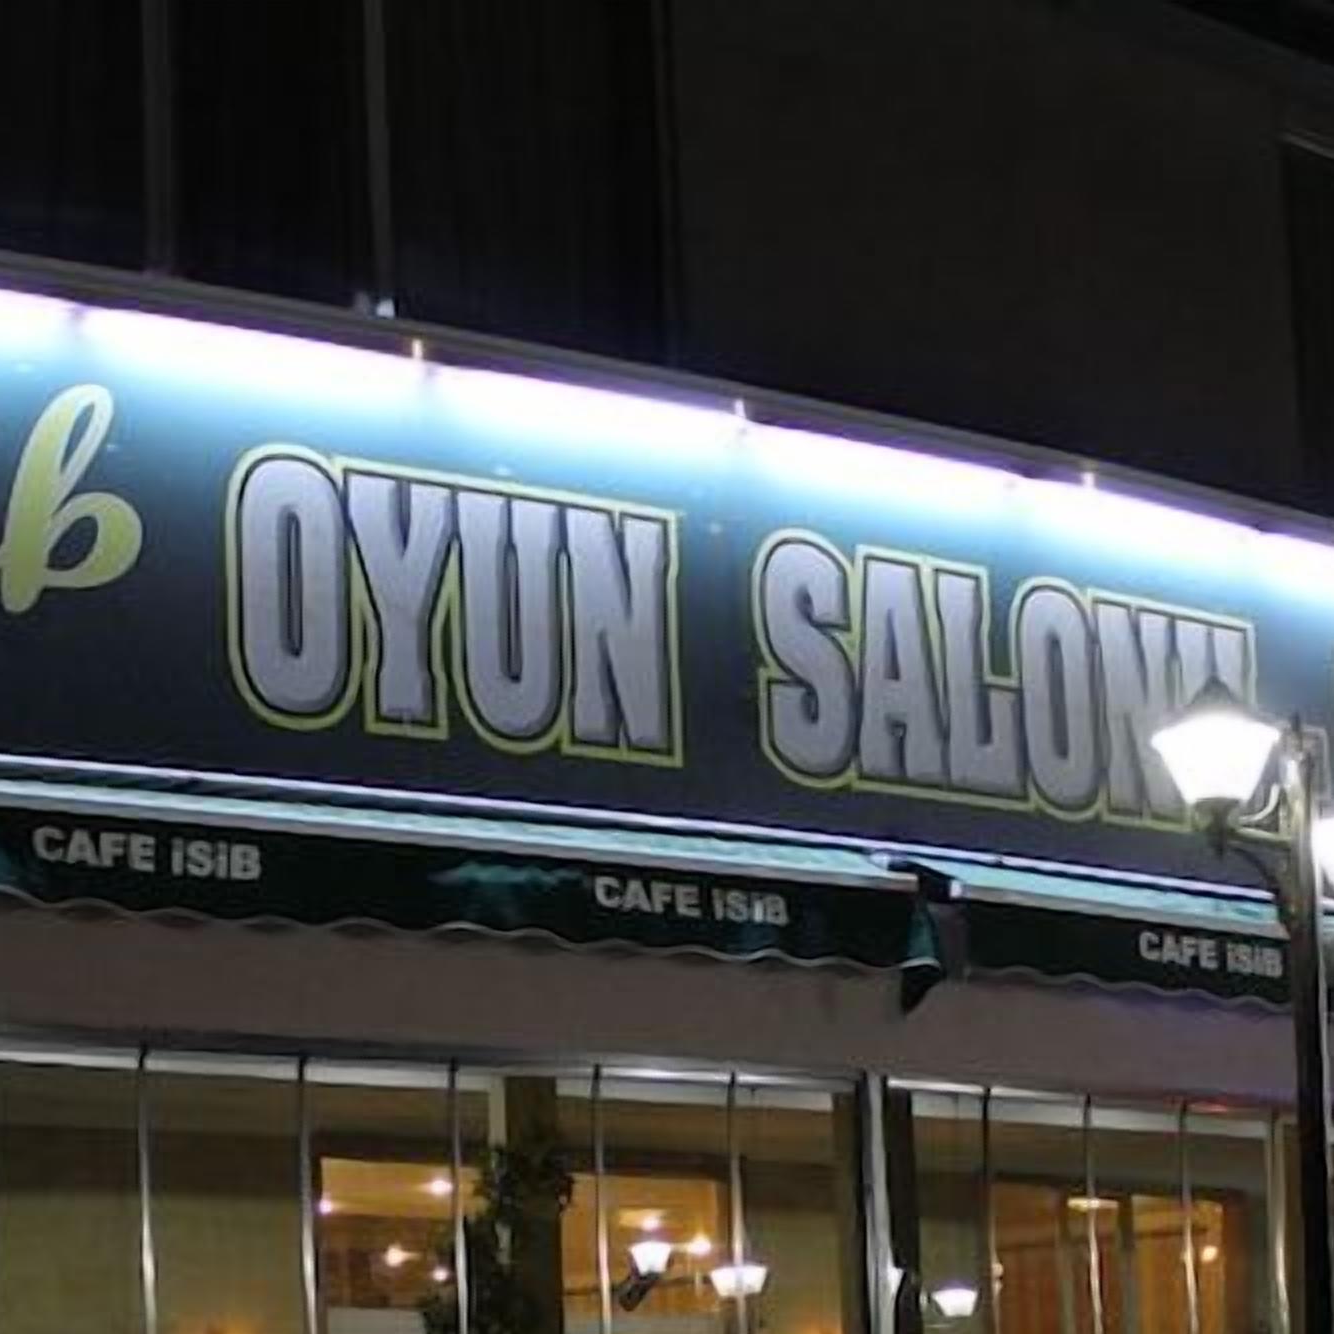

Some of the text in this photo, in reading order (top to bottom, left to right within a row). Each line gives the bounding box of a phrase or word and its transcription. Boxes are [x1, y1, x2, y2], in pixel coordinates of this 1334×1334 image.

[224, 443, 685, 768] OYUN
[32, 825, 156, 873] CAFE
[593, 875, 703, 918] CAFE
[1139, 931, 1219, 971] CAFE
